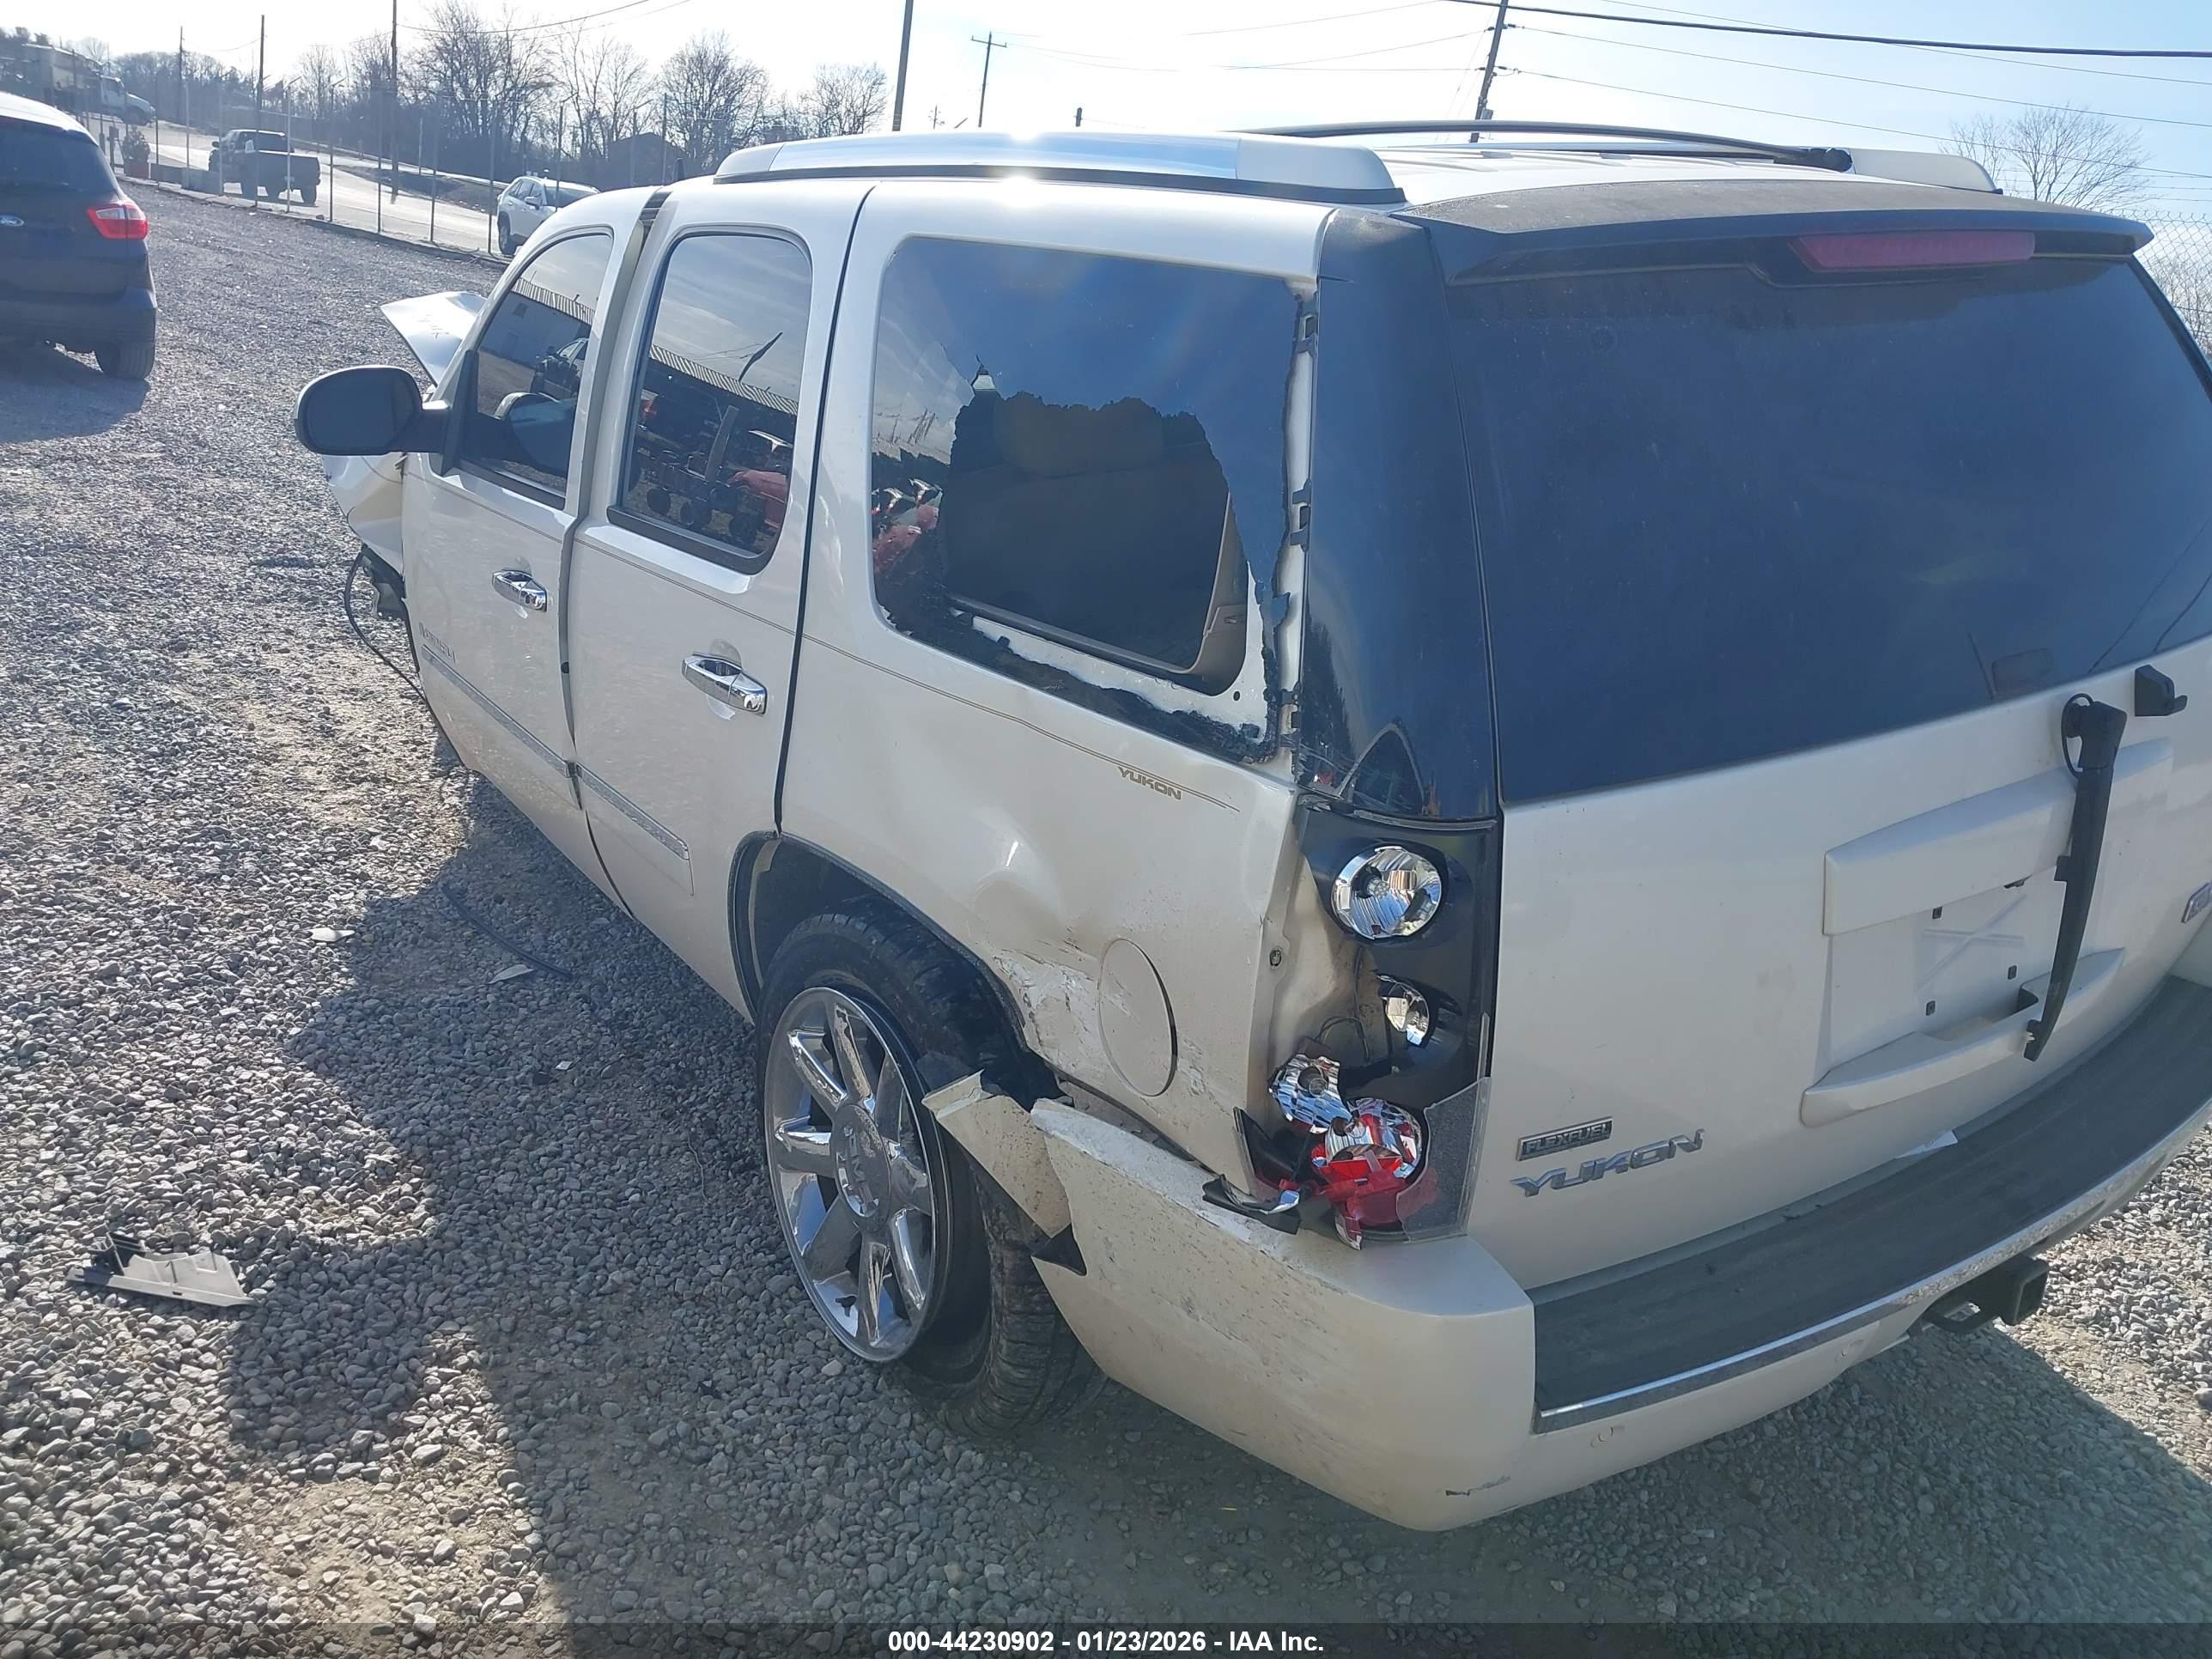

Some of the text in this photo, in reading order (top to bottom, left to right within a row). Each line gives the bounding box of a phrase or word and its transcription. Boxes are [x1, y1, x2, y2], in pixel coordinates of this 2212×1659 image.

[1118, 766, 1182, 801] YUKON
[1525, 1122, 1609, 1155] FLEXFUEL
[1510, 1128, 1705, 1198] YUKON
